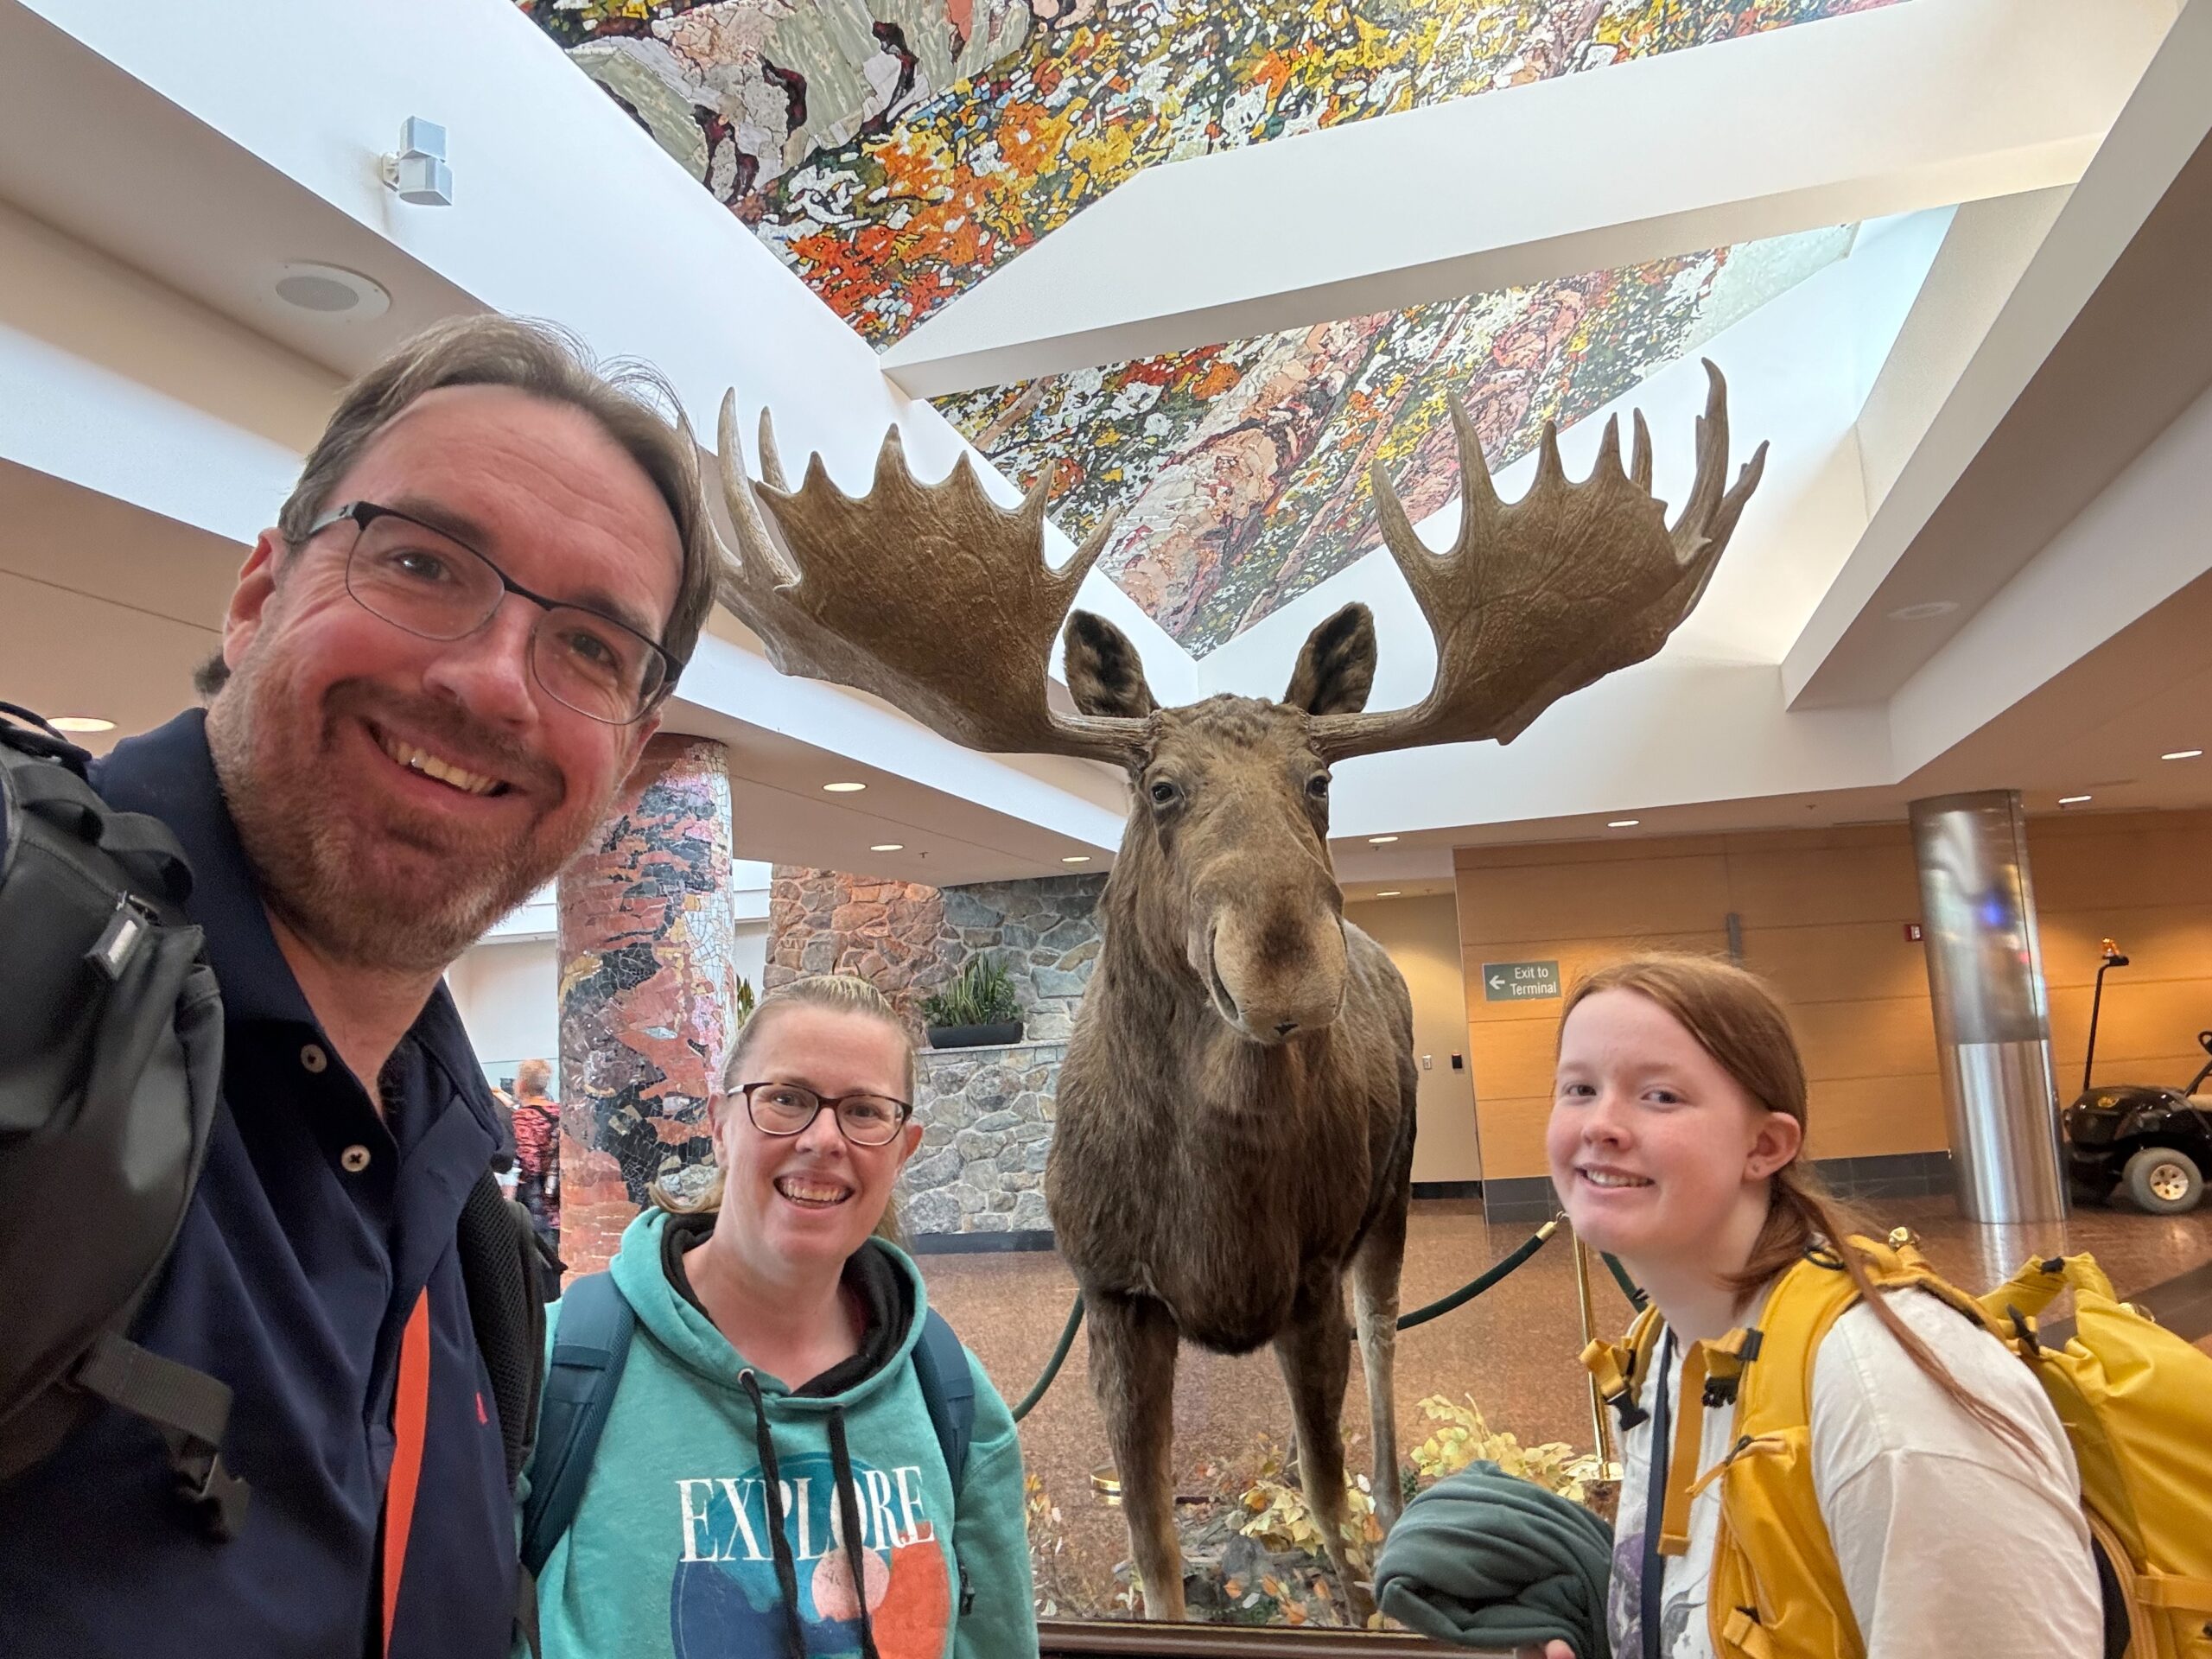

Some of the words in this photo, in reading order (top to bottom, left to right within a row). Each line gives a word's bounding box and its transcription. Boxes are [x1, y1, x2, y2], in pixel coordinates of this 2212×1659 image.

[1515, 967, 1535, 979] Exit
[1537, 966, 1548, 978] to
[1510, 982, 1556, 995] Terminal
